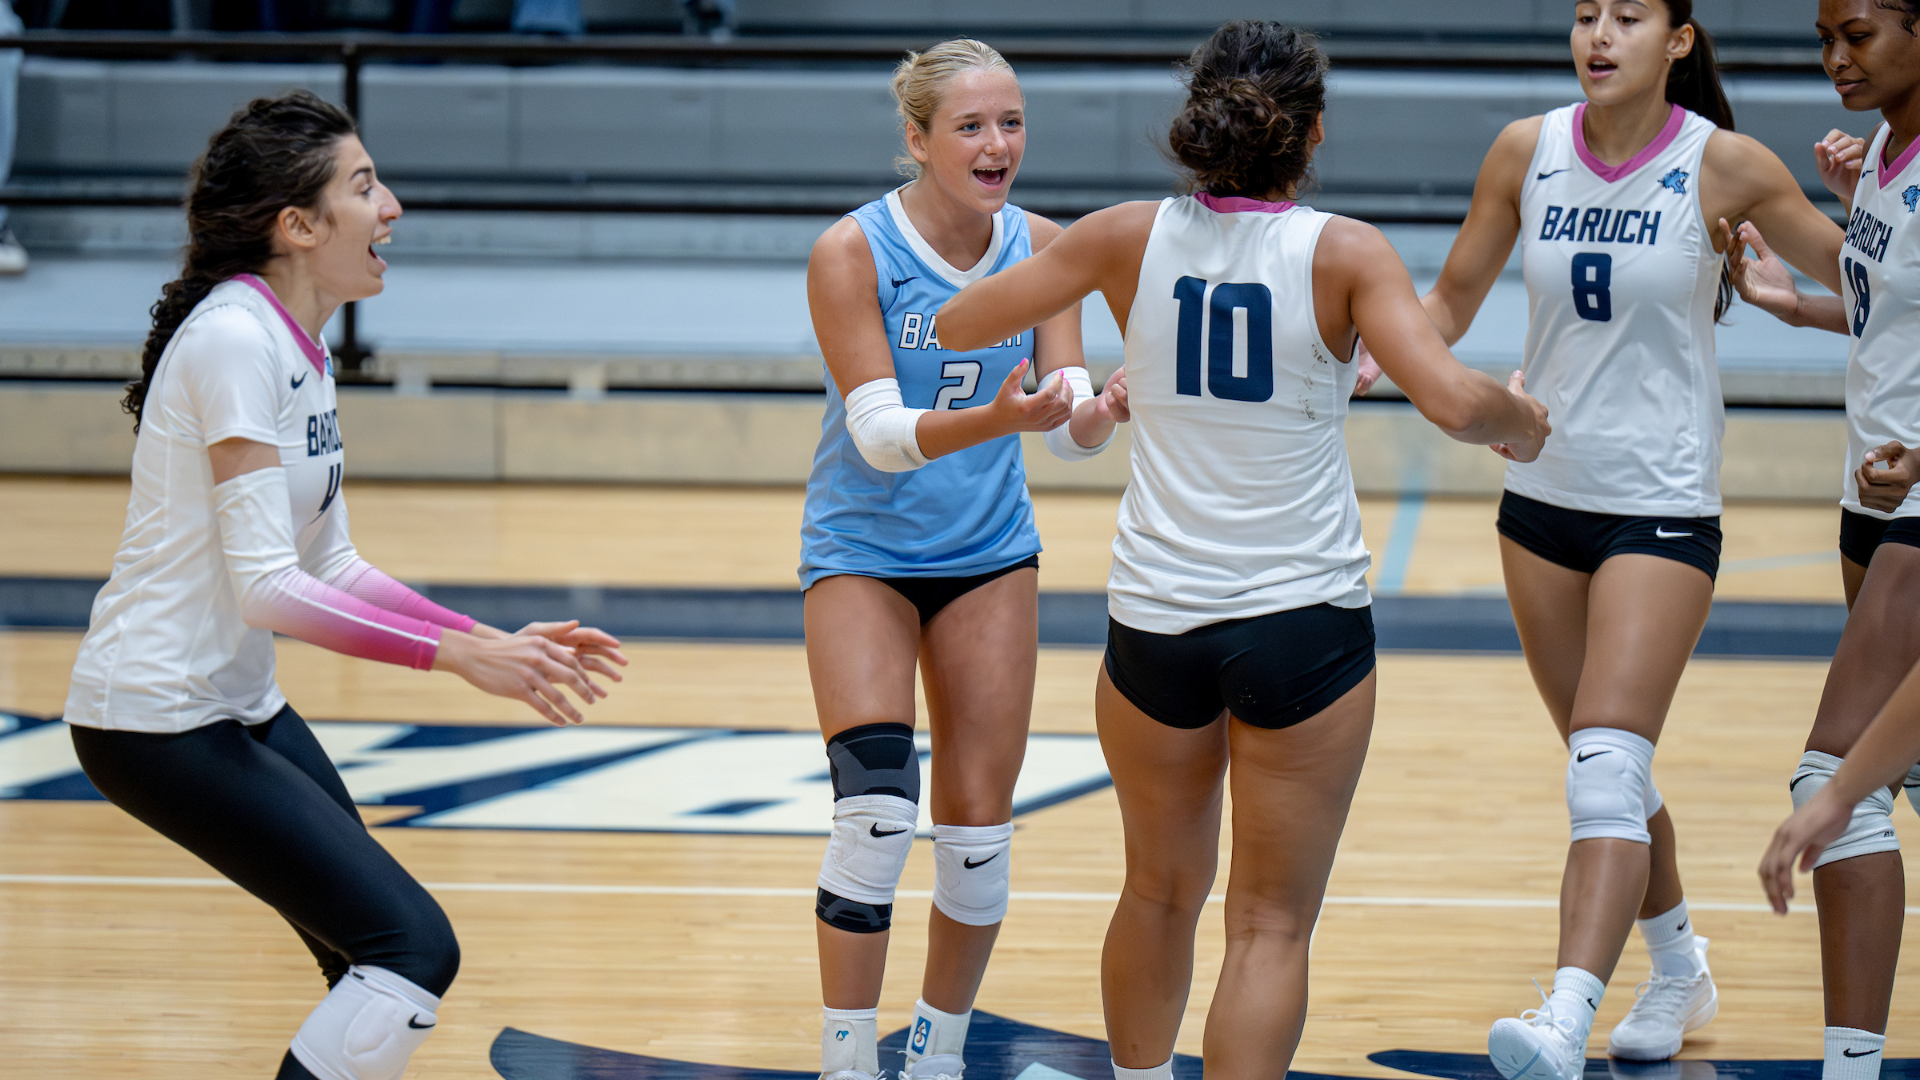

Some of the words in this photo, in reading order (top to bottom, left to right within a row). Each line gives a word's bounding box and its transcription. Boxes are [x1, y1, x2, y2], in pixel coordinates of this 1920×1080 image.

[1539, 205, 1661, 245] BARUCH
[1845, 206, 1893, 263] BARUCH
[1571, 252, 1612, 322] 8
[1845, 256, 1870, 339] 18
[1173, 275, 1273, 402] 10
[933, 360, 983, 411] 2
